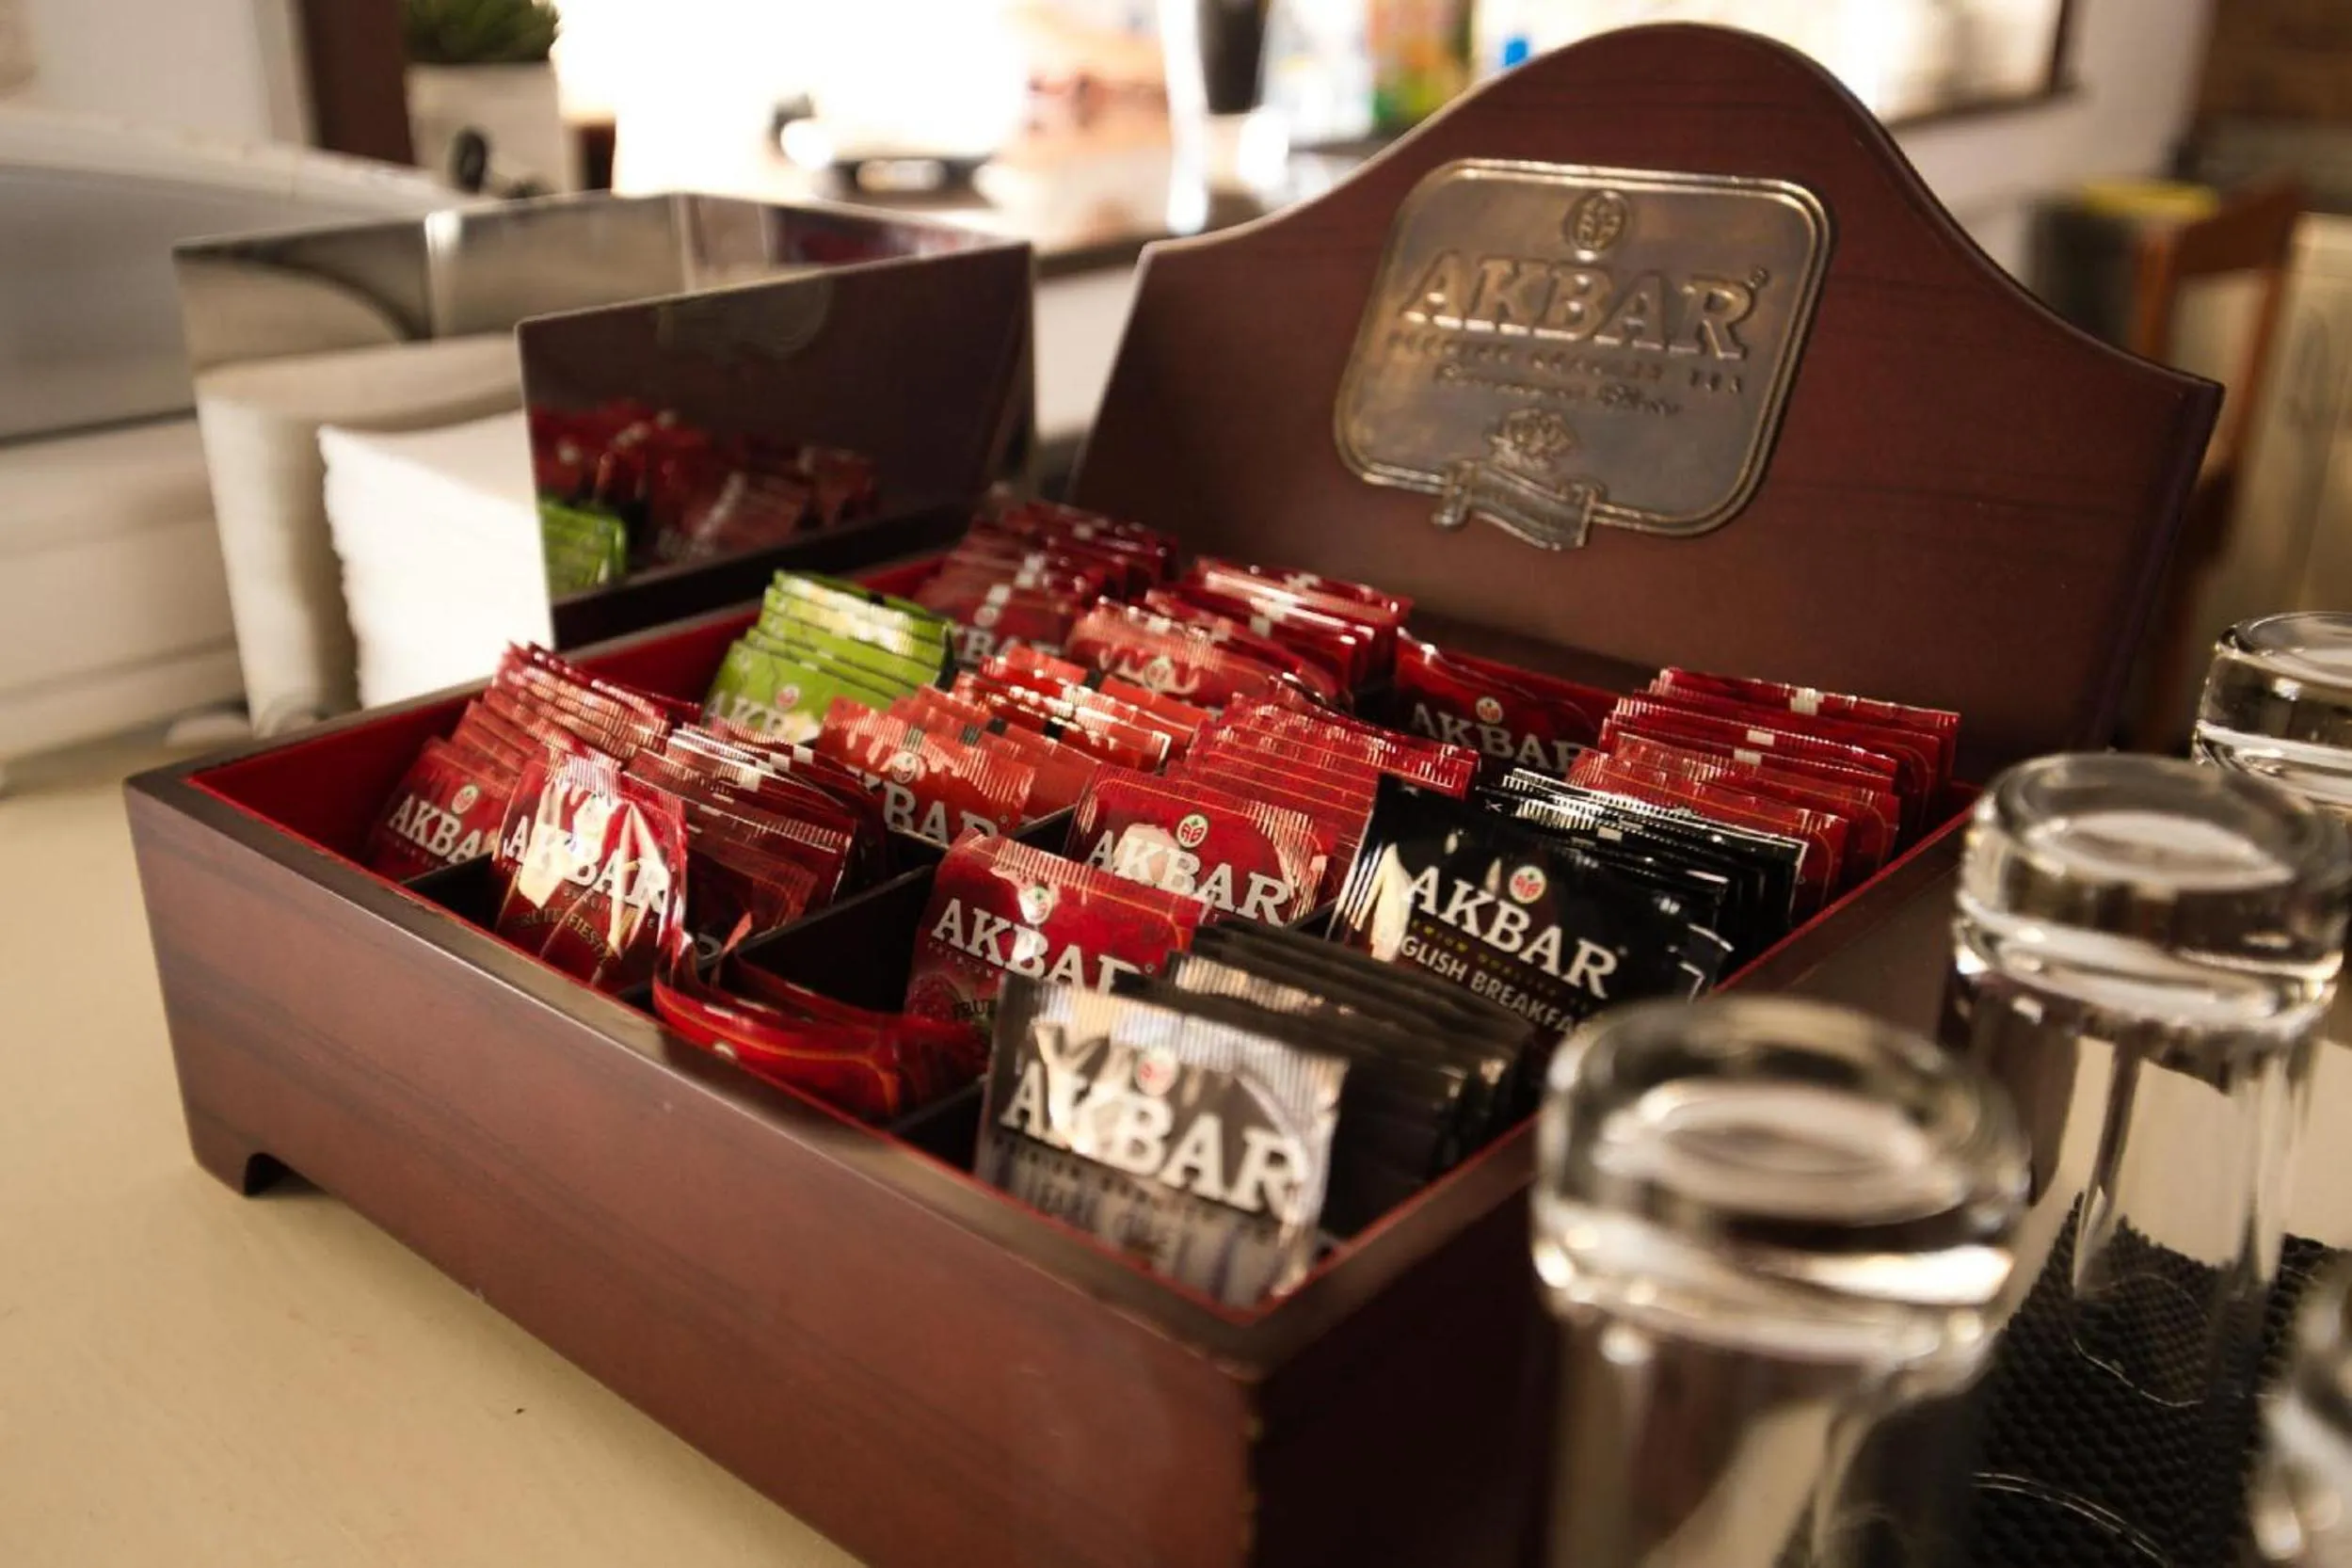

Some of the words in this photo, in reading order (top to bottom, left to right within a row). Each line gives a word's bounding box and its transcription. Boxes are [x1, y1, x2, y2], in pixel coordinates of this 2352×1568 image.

[1400, 250, 1750, 360] AKBAR
[388, 795, 483, 864] AKBA
[1085, 829, 1289, 928] AKBAR
[1404, 866, 1618, 1000] AKBAR
[1400, 936, 1468, 982] GLISH
[1470, 969, 1576, 1034] BREAKFA
